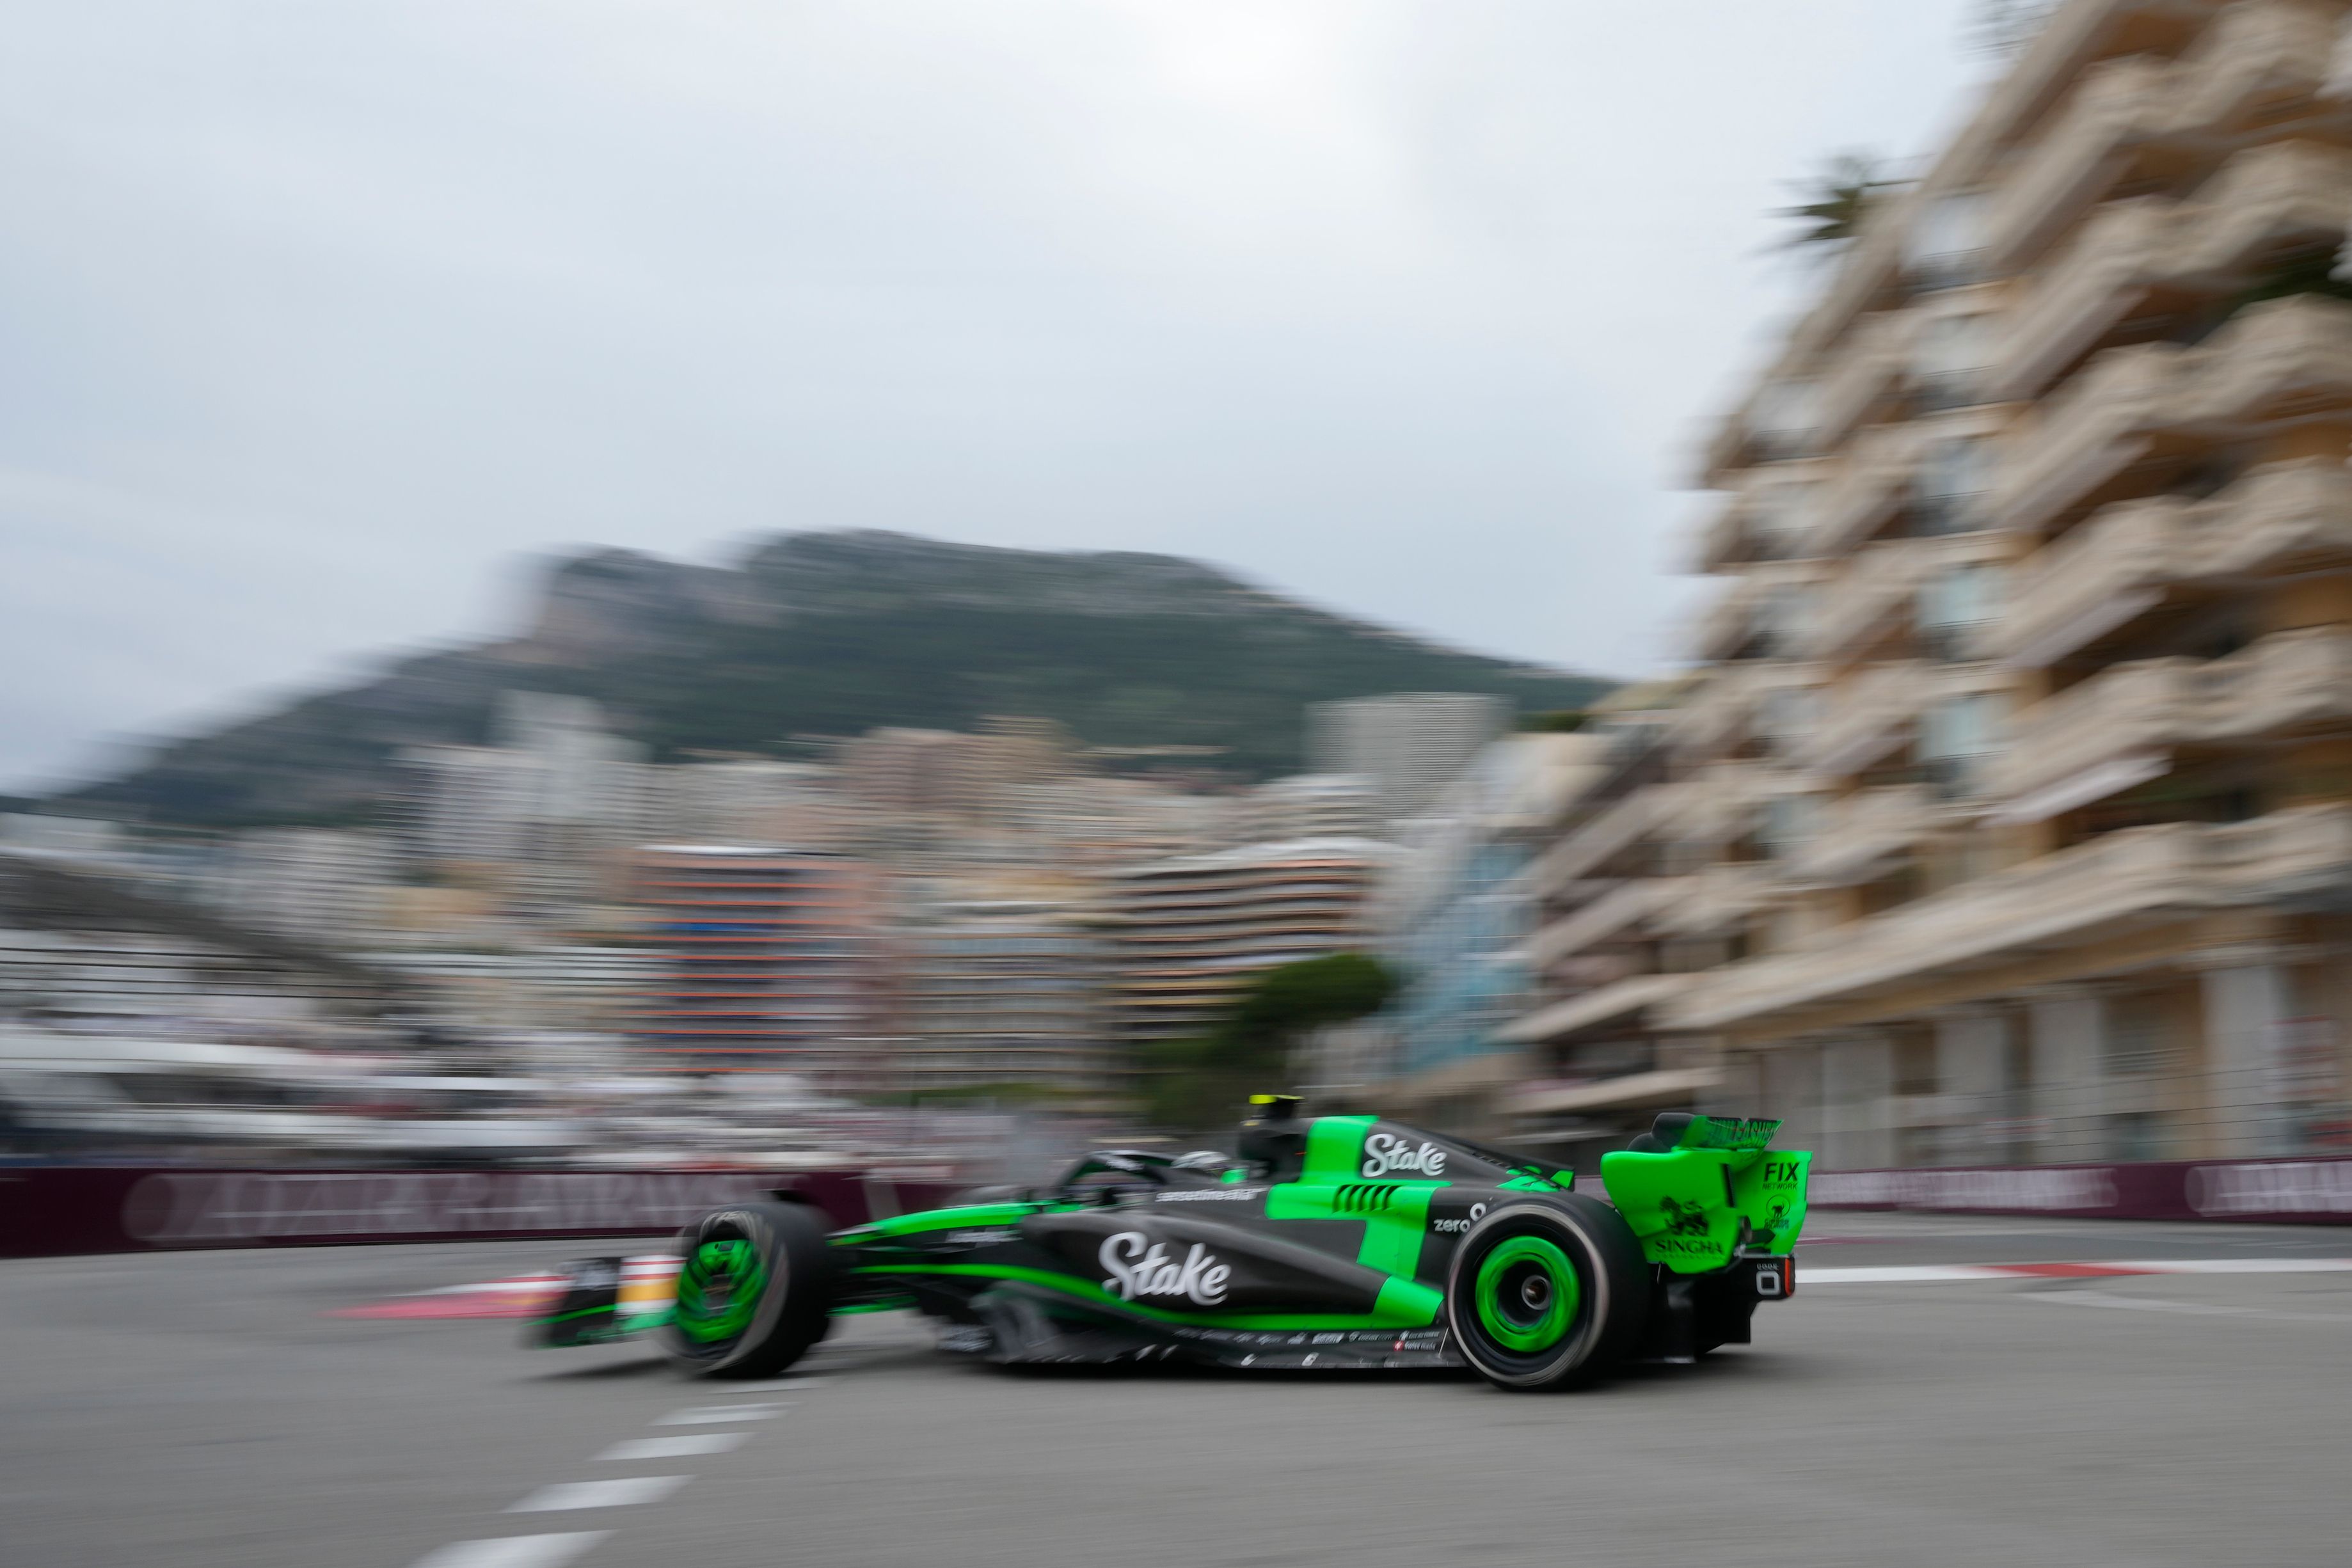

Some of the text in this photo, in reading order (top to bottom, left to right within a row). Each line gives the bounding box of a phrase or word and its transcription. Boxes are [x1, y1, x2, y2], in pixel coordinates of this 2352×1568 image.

[1362, 1133, 1447, 1177] Stake
[1764, 1162, 1800, 1181] FIX
[1433, 1219, 1470, 1233] zero
[1655, 1239, 1725, 1255] SINGHA
[1098, 1231, 1232, 1306] Stake
